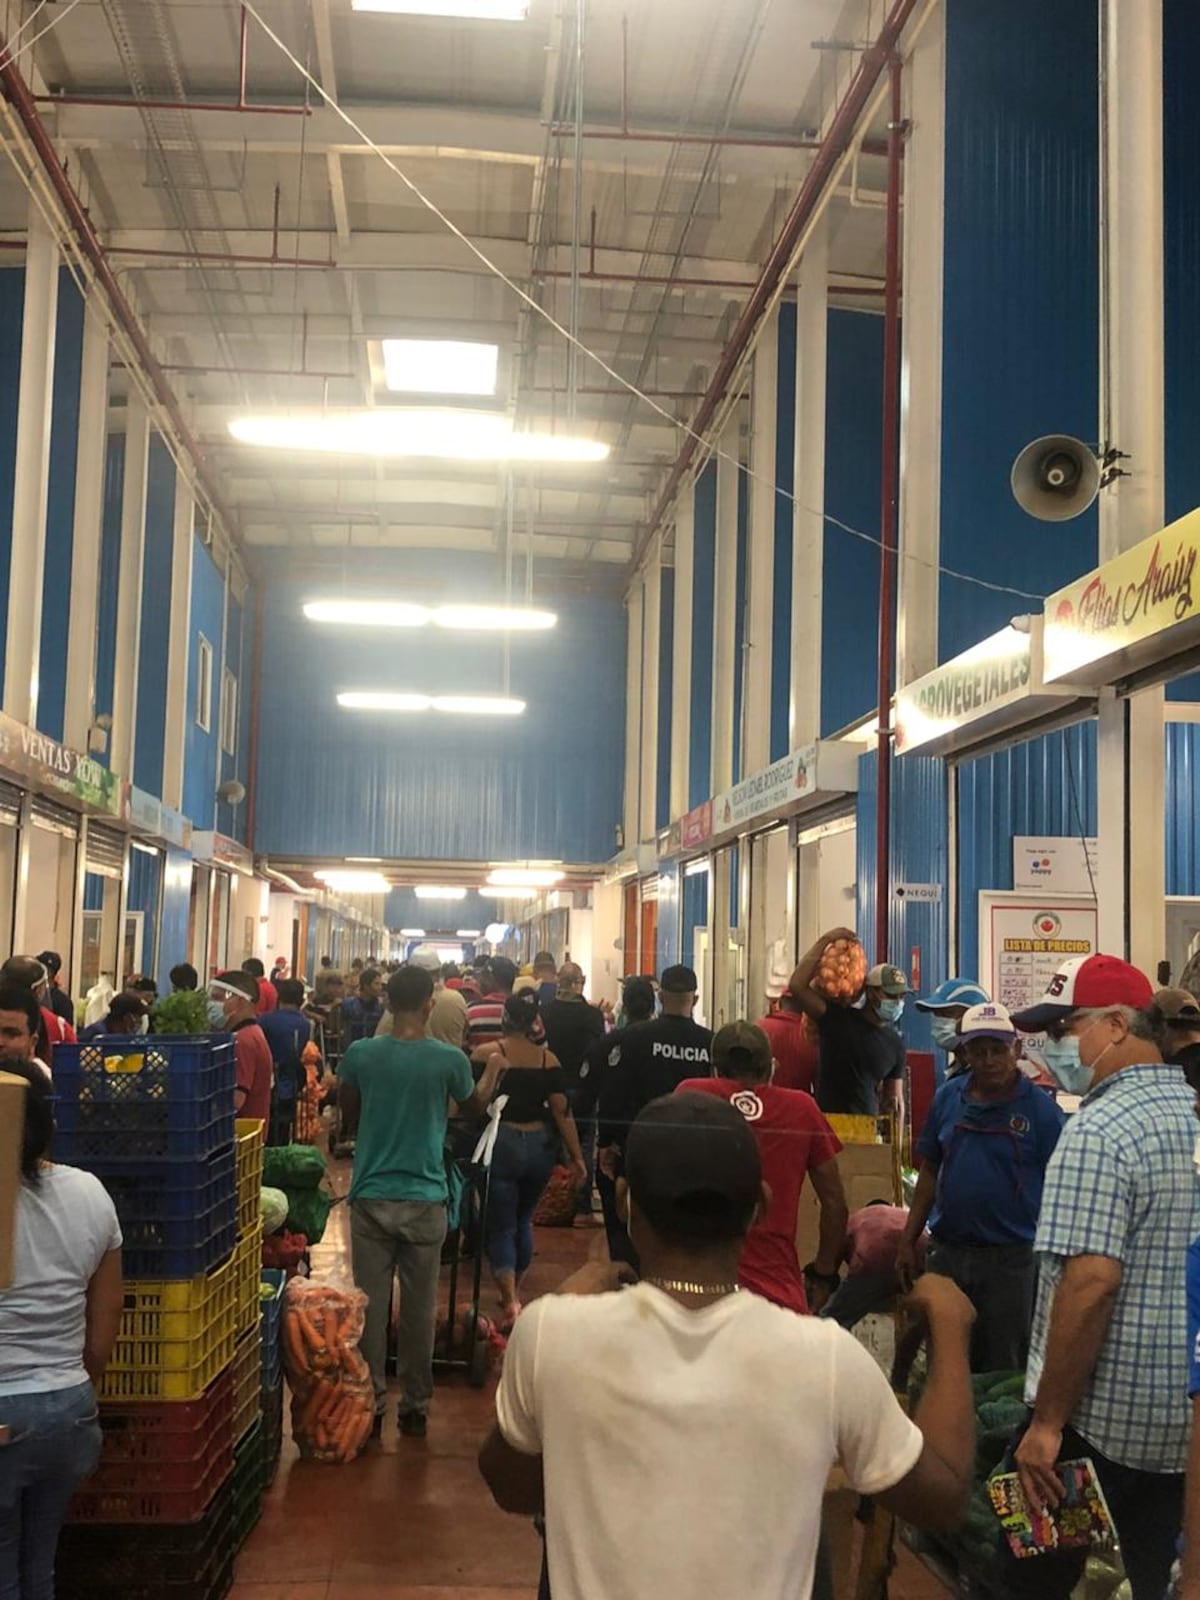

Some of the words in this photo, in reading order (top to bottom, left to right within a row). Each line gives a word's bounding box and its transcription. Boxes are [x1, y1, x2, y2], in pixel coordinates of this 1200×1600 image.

[21, 727, 70, 773] VENTAS
[1004, 938, 1032, 952] LISTA
[1033, 938, 1046, 952] DE
[1047, 939, 1090, 953] PRECIOS
[652, 1042, 709, 1062] POLICIA
